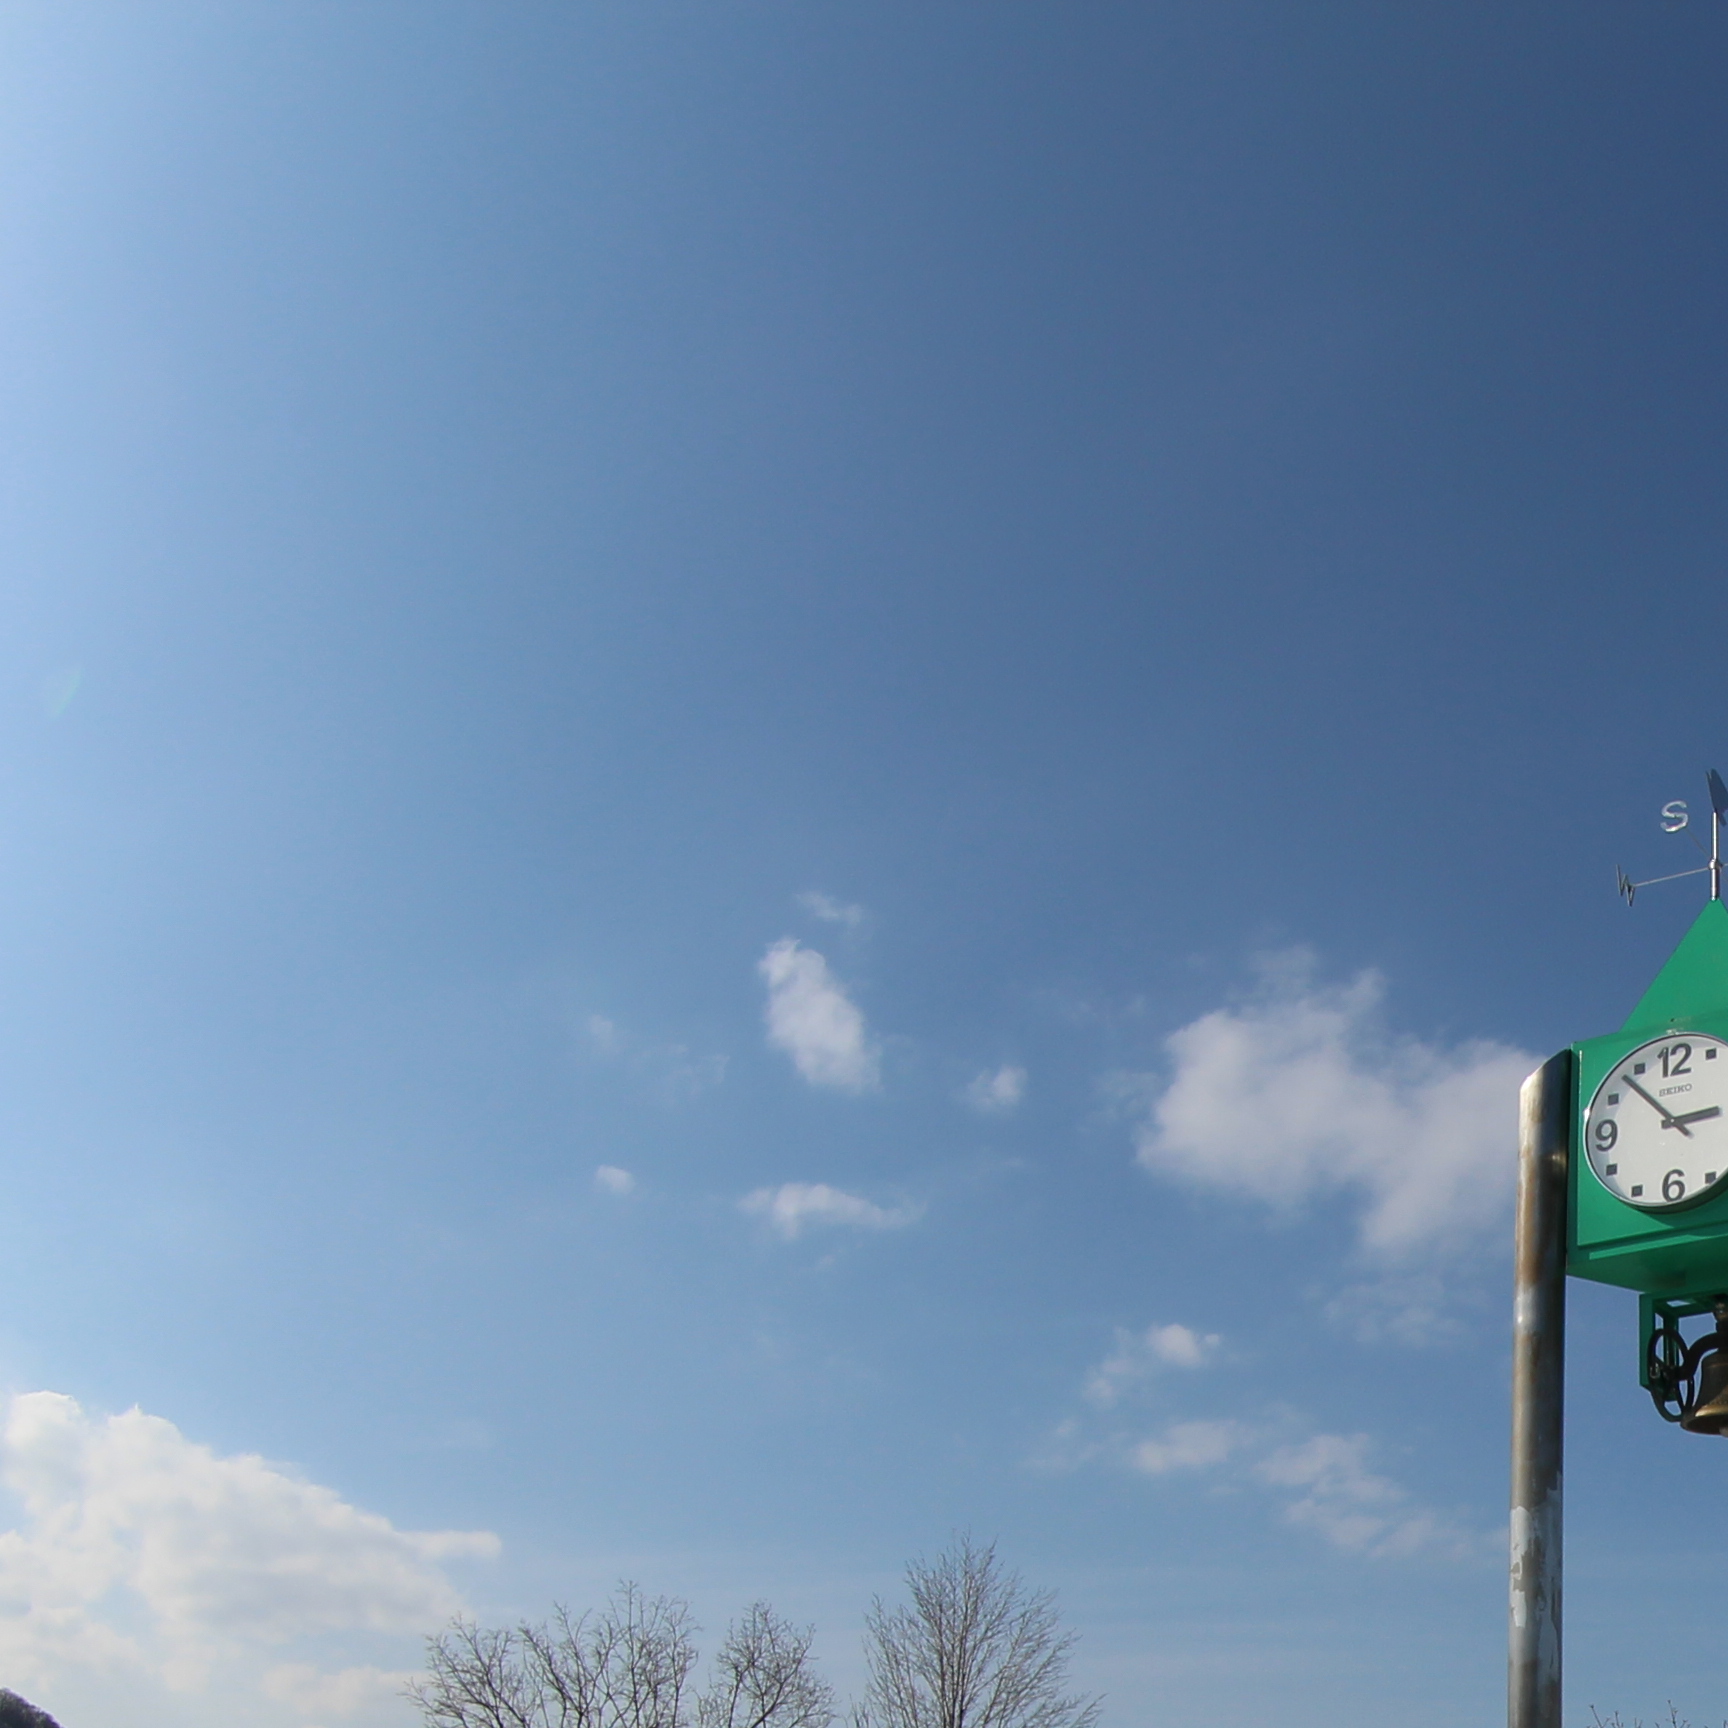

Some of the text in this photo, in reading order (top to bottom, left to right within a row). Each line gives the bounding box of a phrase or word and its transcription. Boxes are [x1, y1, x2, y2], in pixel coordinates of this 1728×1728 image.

[1660, 800, 1688, 833] S
[1657, 1043, 1692, 1078] 12
[1659, 1083, 1692, 1097] SEIKO
[1595, 1119, 1618, 1151] 9
[1662, 1169, 1685, 1202] 6
